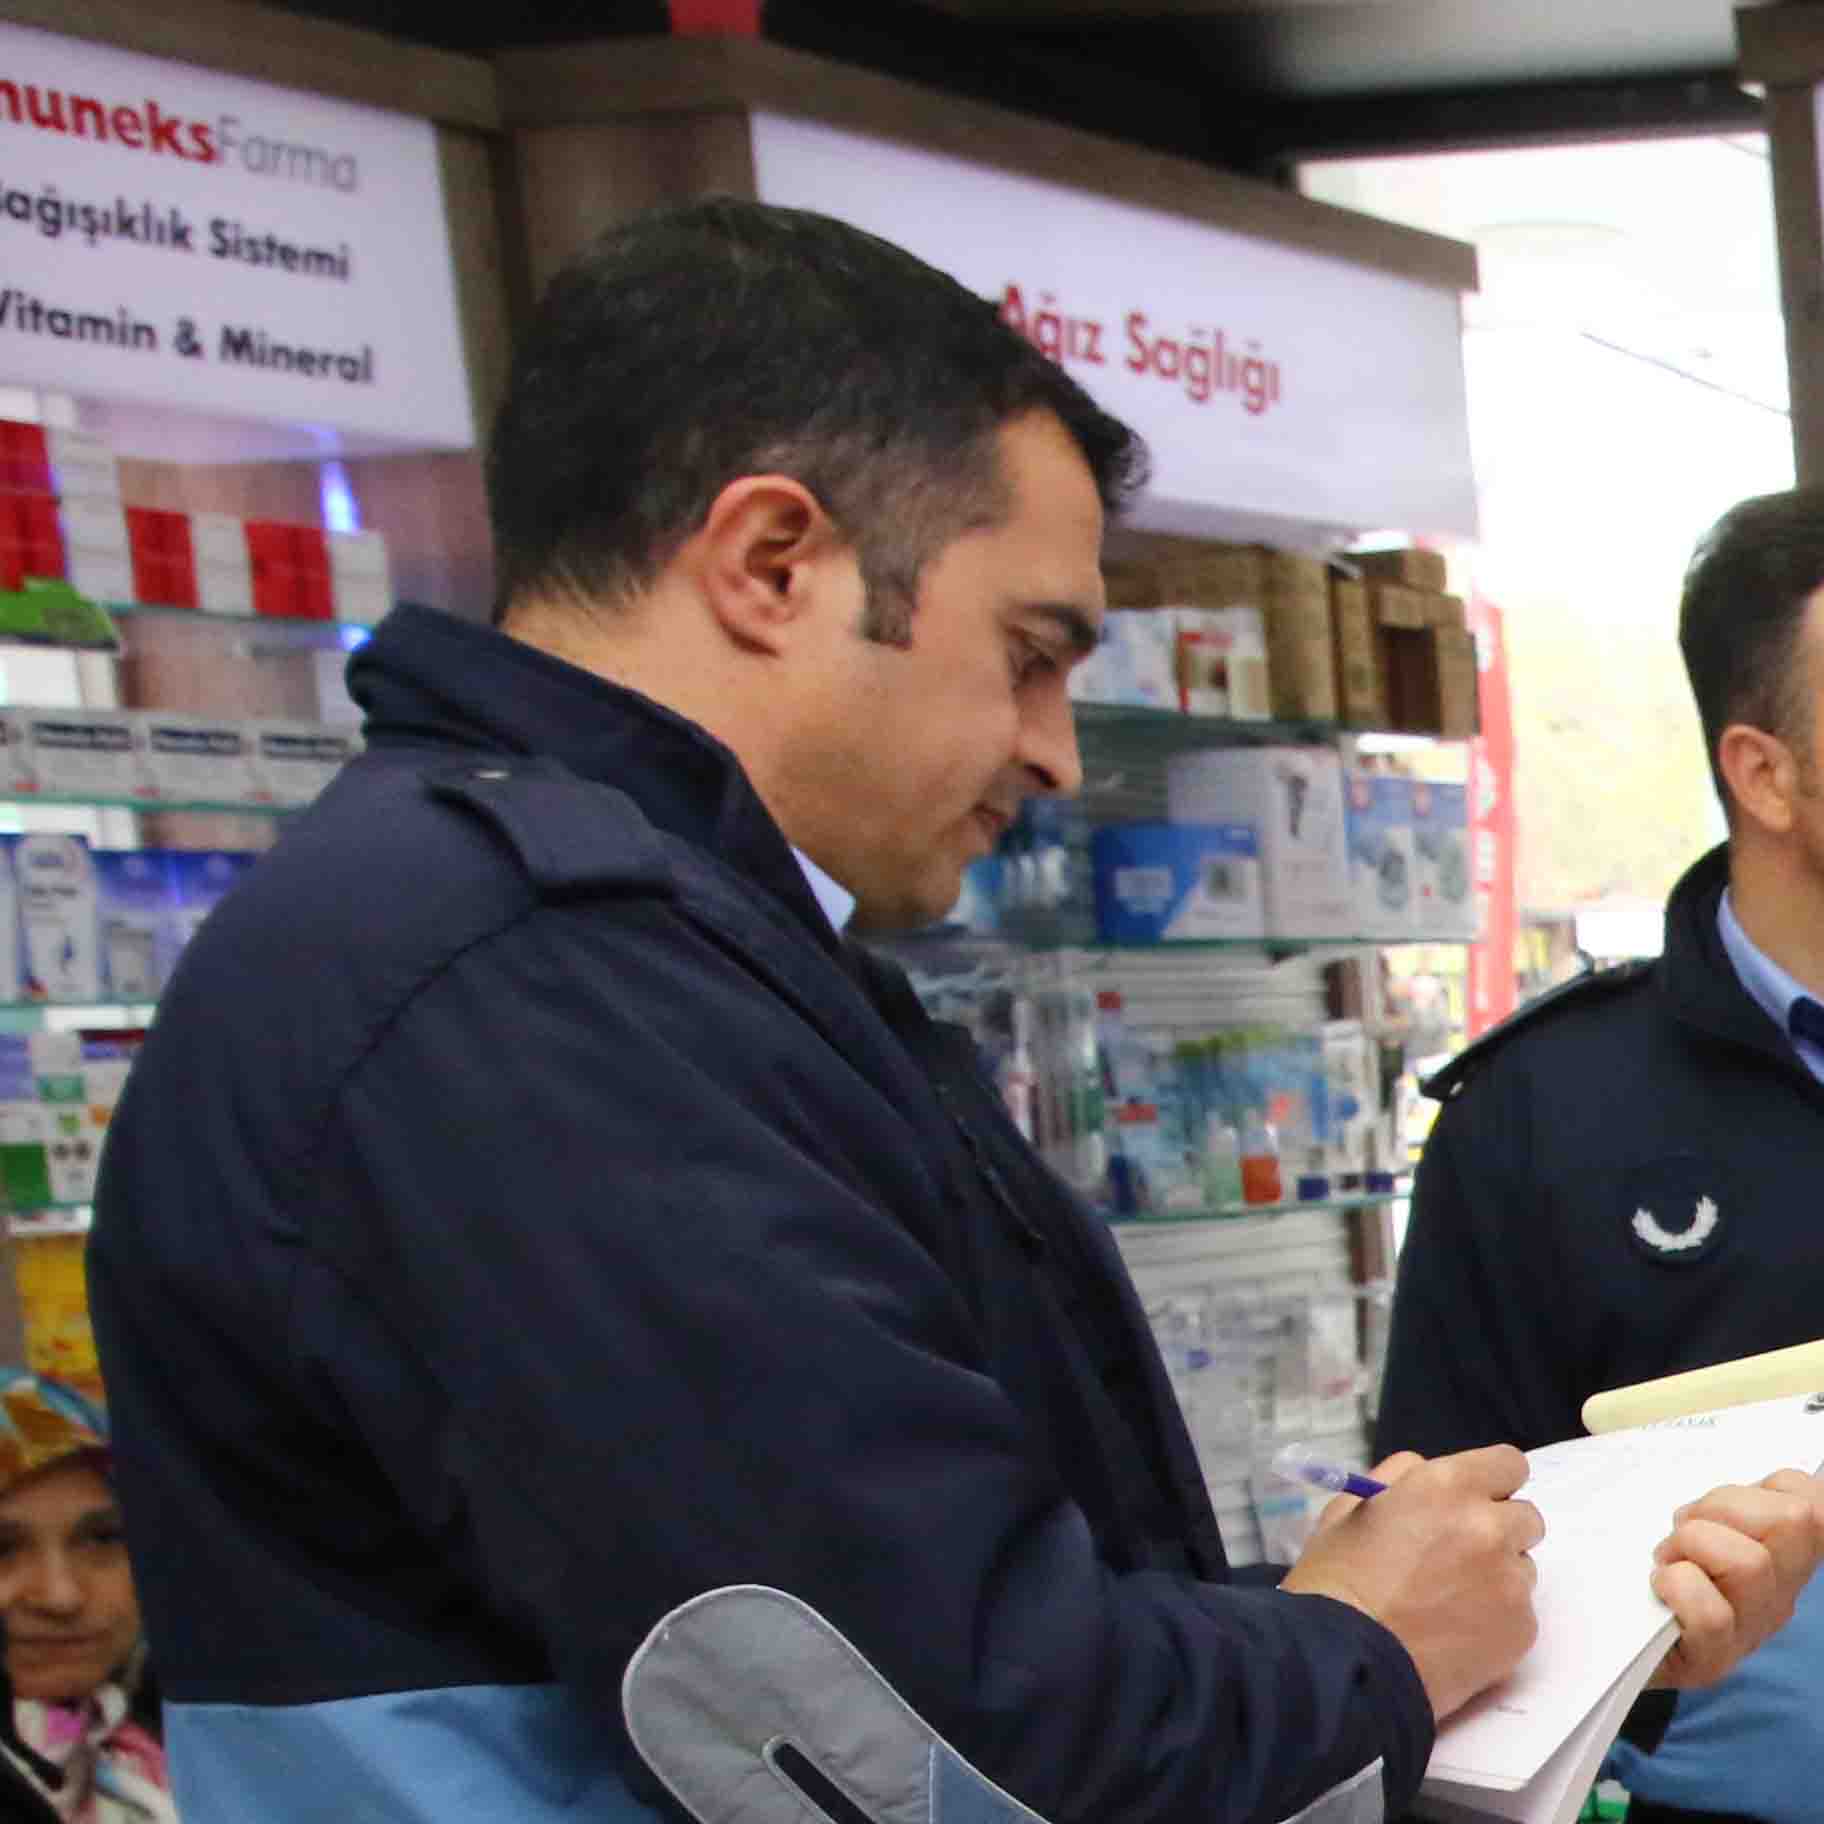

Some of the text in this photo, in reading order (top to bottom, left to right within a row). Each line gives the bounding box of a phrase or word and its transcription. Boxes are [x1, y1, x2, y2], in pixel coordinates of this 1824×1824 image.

[0, 180, 350, 281] ağışıklık Sistemi
[172, 316, 204, 359] &
[219, 324, 374, 384] Mineral
[1124, 311, 1283, 417] Sağlığı
